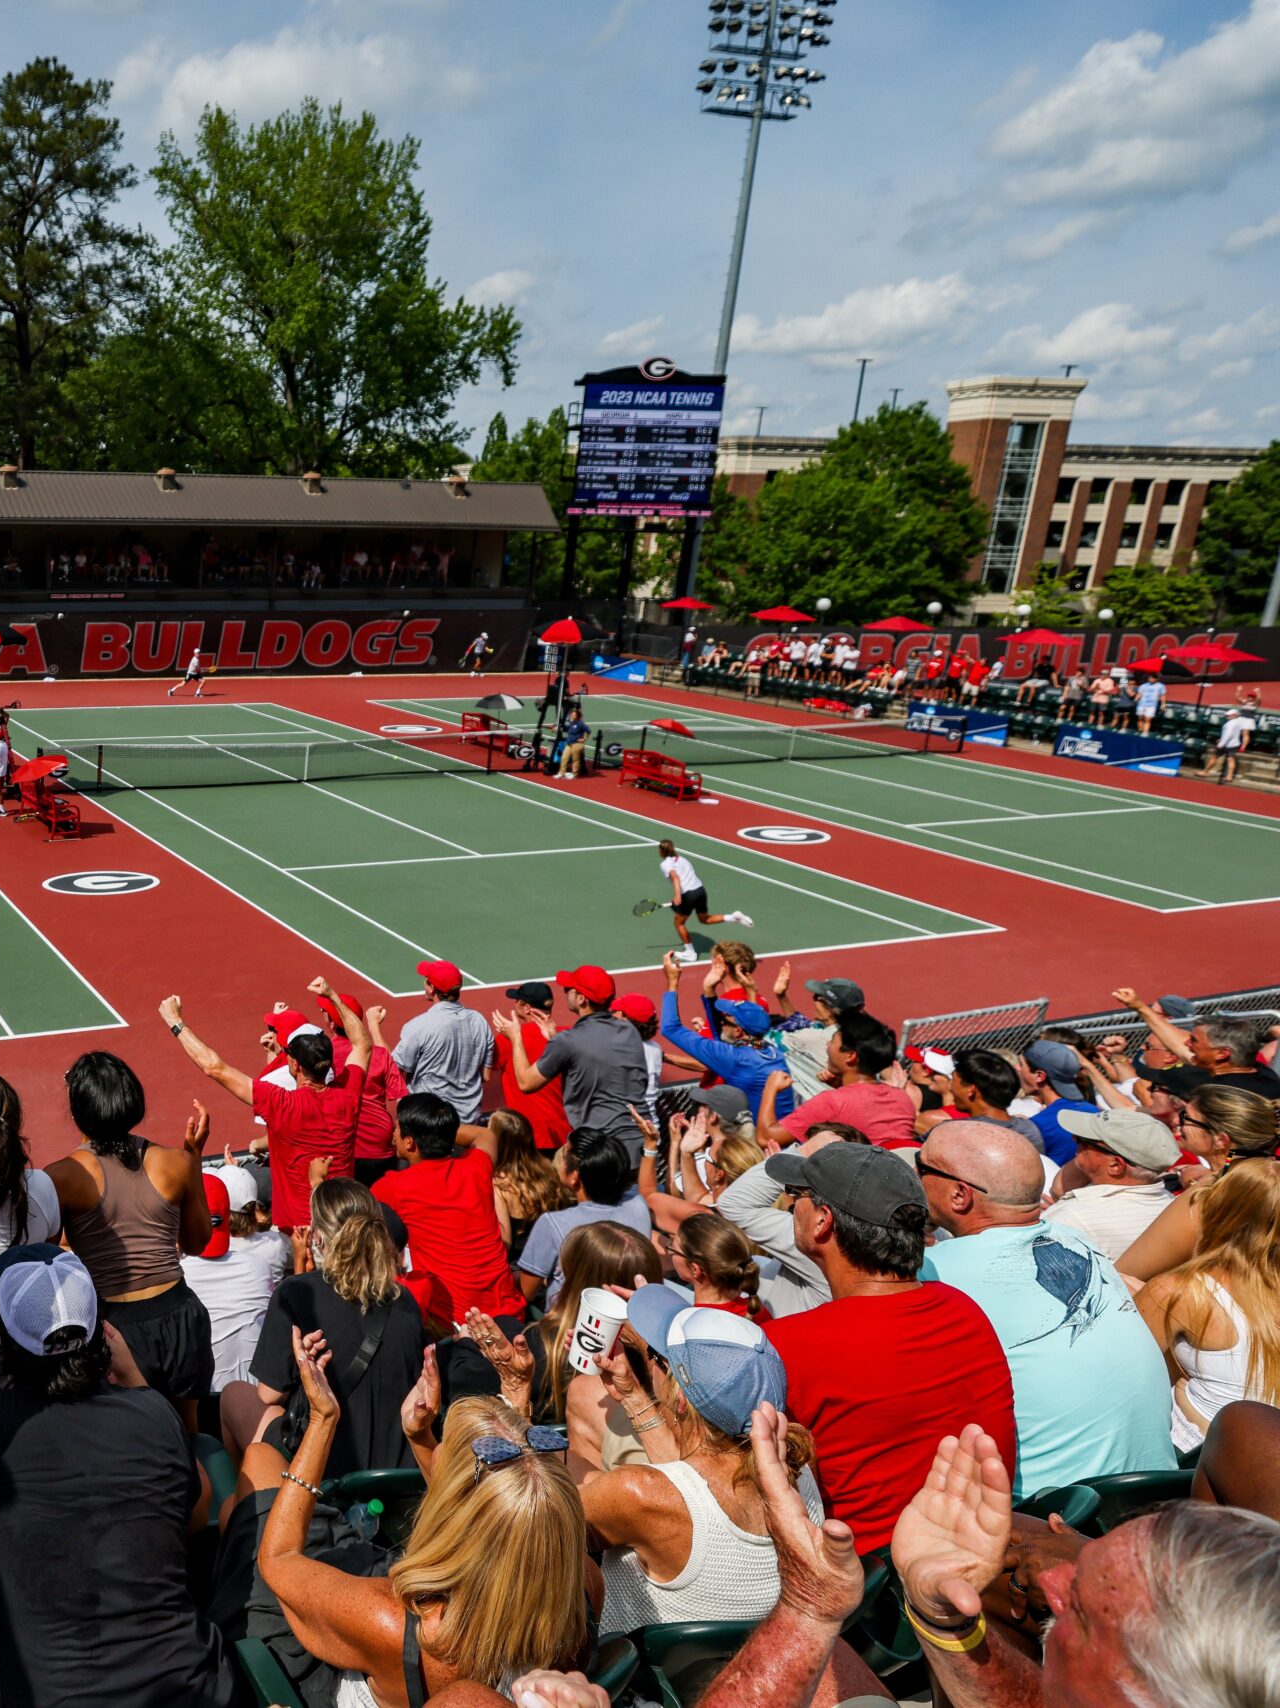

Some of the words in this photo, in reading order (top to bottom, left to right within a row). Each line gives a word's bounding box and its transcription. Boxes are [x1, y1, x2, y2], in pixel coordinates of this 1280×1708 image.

[600, 390, 634, 404] 2023
[634, 391, 668, 405] NCAA
[668, 391, 715, 407] TENNIS
[81, 618, 441, 673] BULLDOGS
[745, 632, 982, 676] GORGIA
